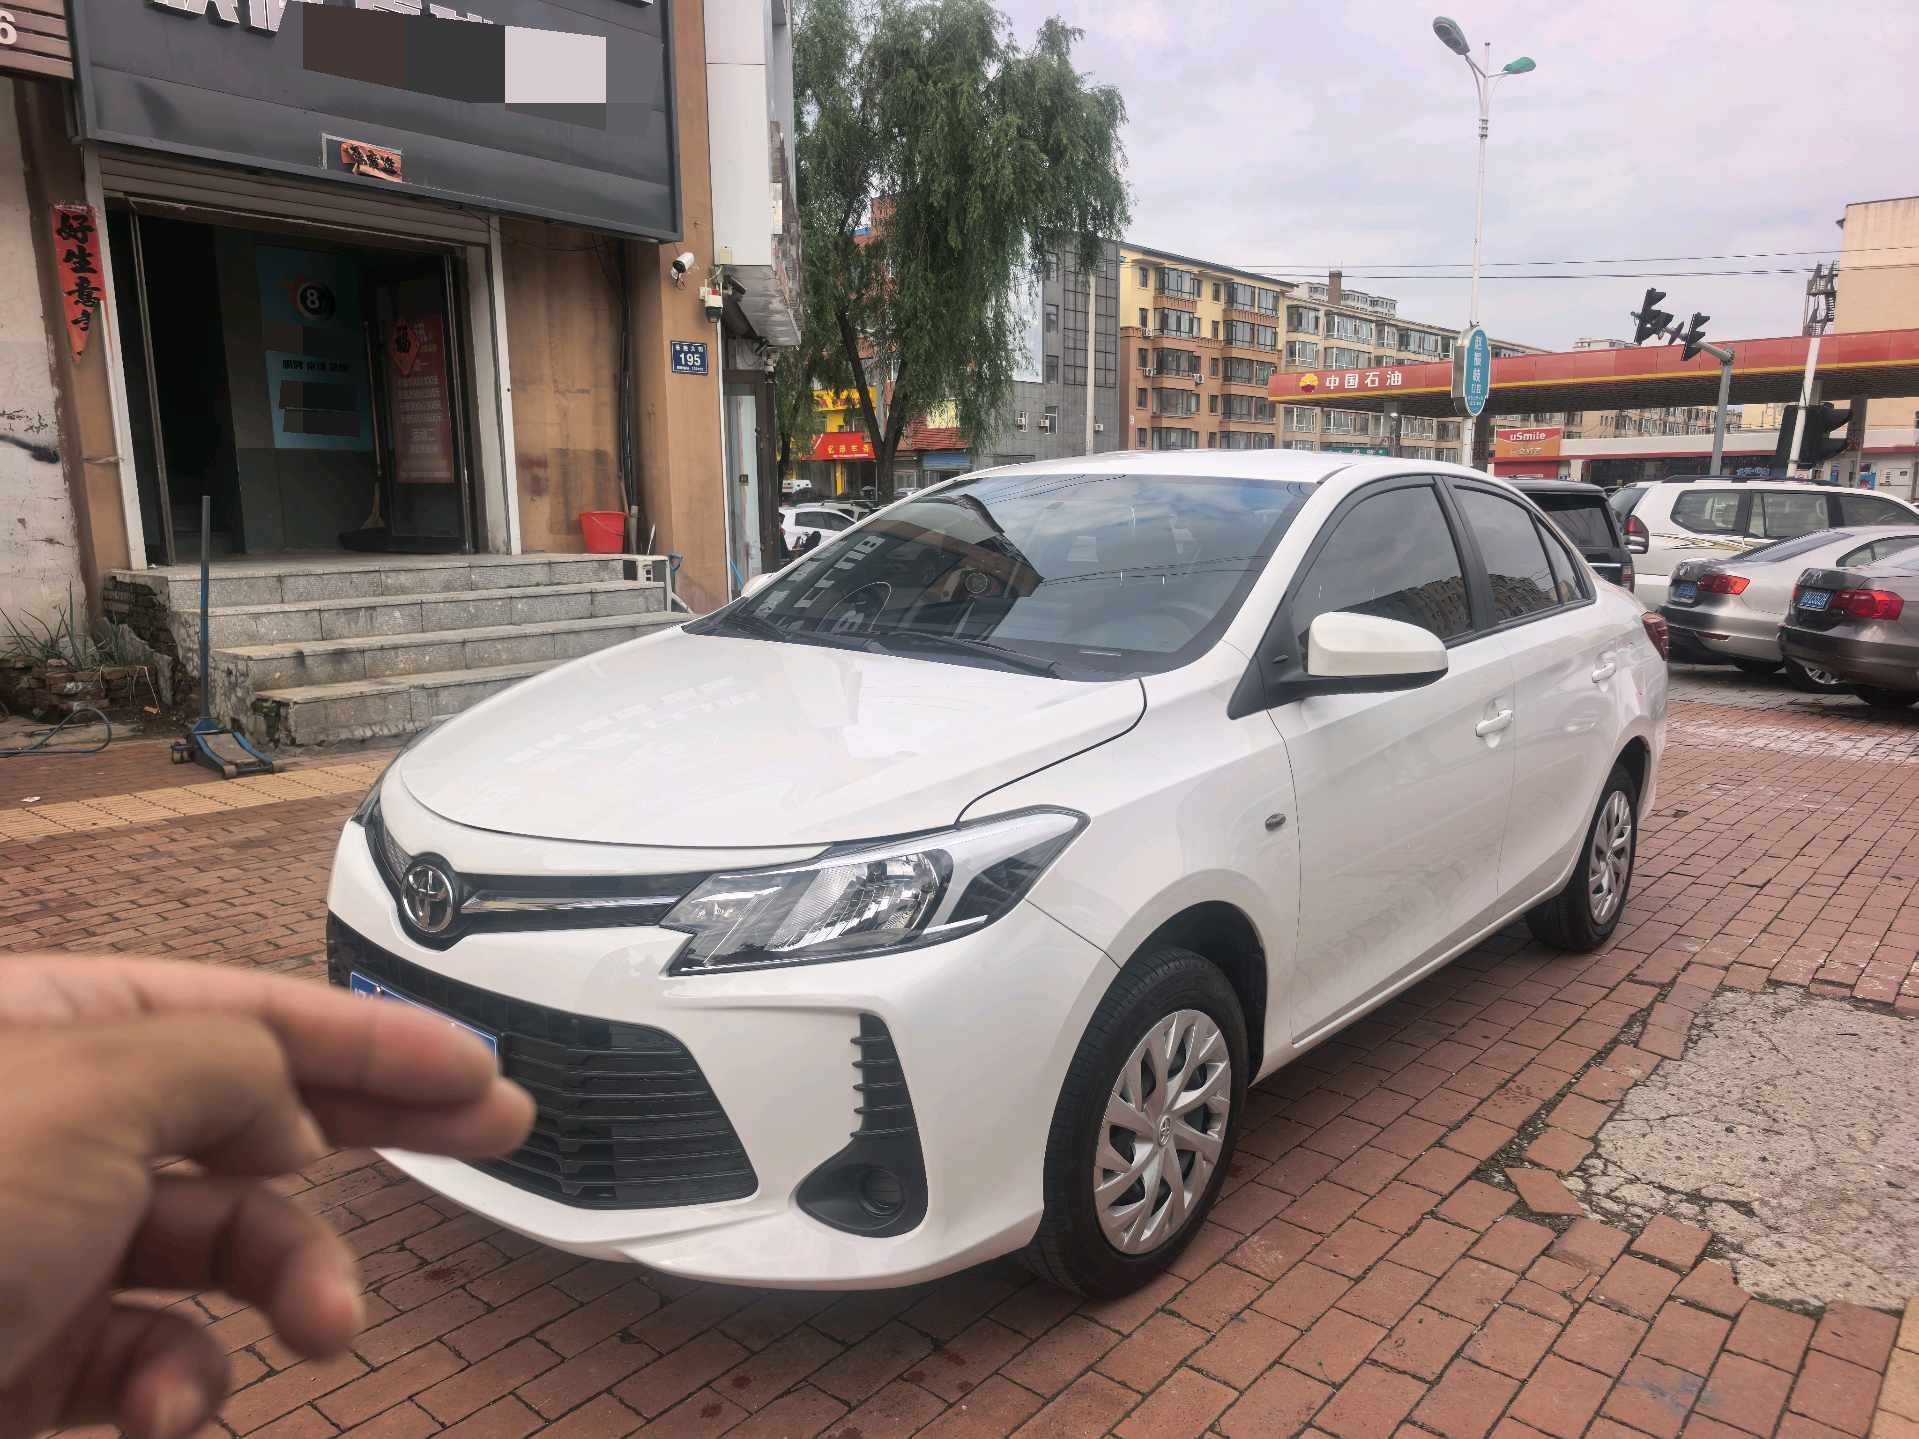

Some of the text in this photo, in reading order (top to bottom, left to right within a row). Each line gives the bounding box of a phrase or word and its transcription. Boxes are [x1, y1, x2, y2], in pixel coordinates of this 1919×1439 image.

[306, 288, 320, 309] 8
[679, 352, 701, 366] 195
[1326, 370, 1402, 390] 中国石油
[1510, 431, 1546, 441] uSmile
